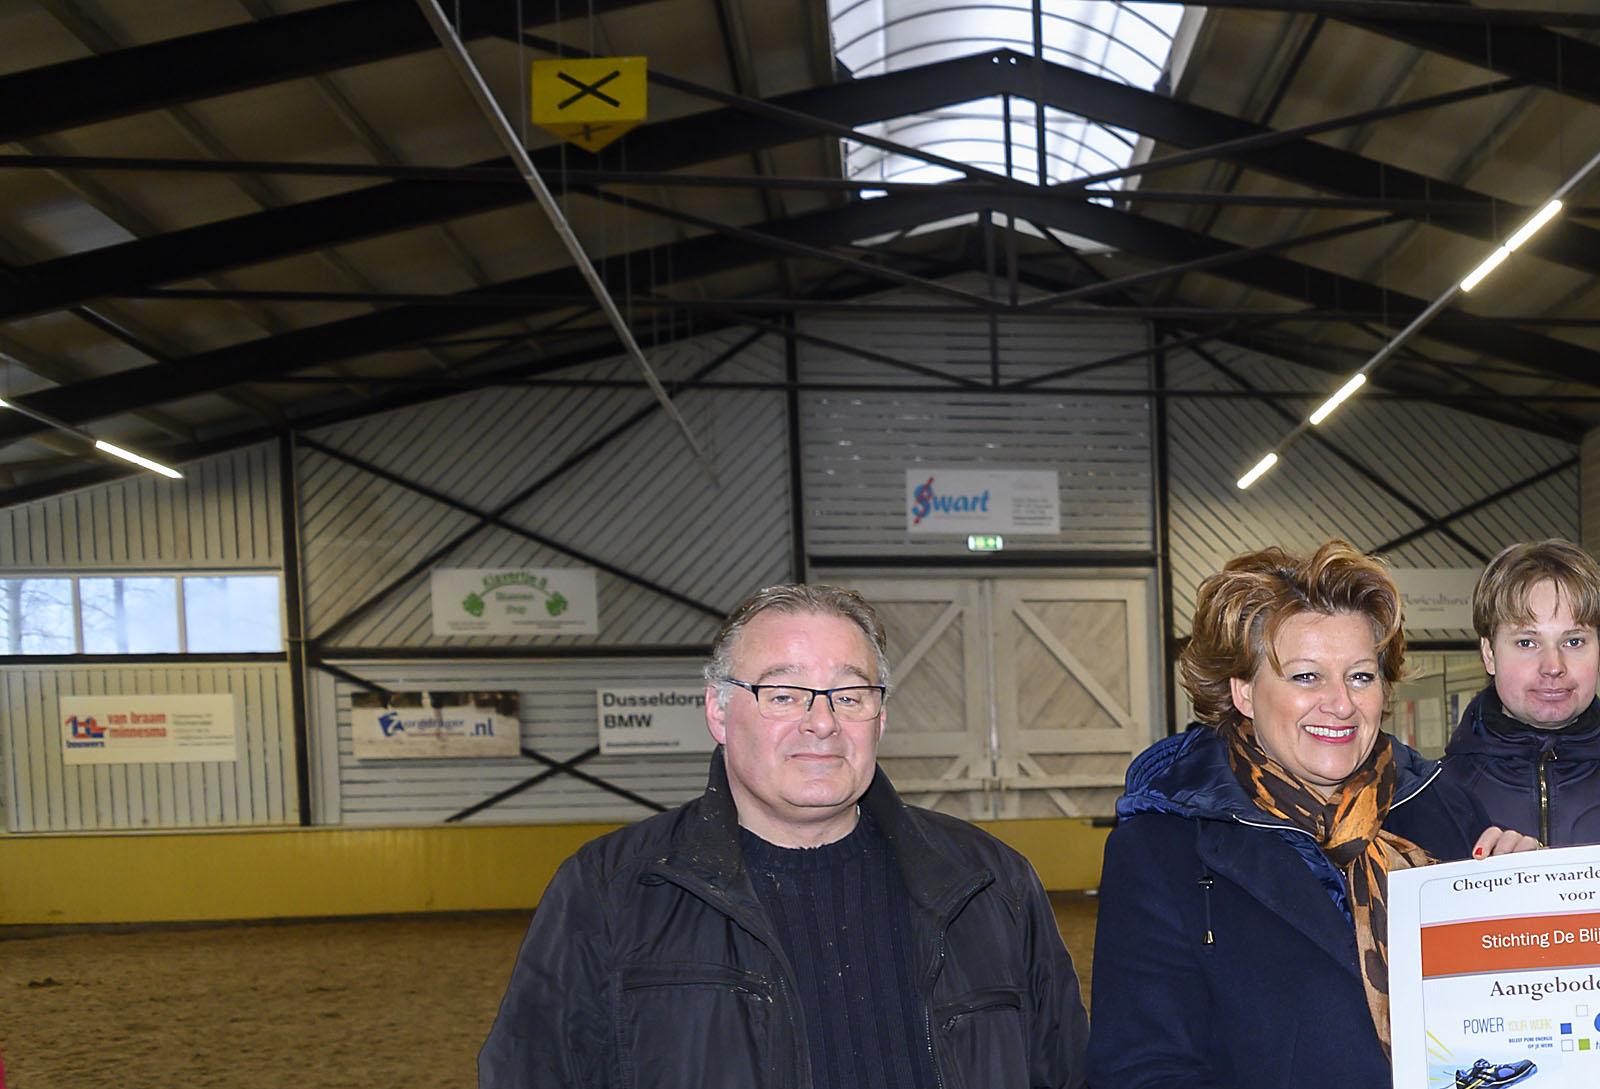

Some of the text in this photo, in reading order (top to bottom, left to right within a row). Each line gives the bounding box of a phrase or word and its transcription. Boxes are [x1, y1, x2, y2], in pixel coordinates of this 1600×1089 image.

[912, 483, 990, 520] Swart
[603, 692, 706, 708] Dusseldorp
[108, 712, 166, 724] van braam
[604, 714, 652, 728] BMW
[1453, 876, 1512, 892] Cheque
[1514, 872, 1540, 885] Ter
[1559, 891, 1595, 902] voor
[1481, 931, 1550, 949] Stichting
[1554, 930, 1575, 944] De
[1463, 1017, 1505, 1035] POWER
